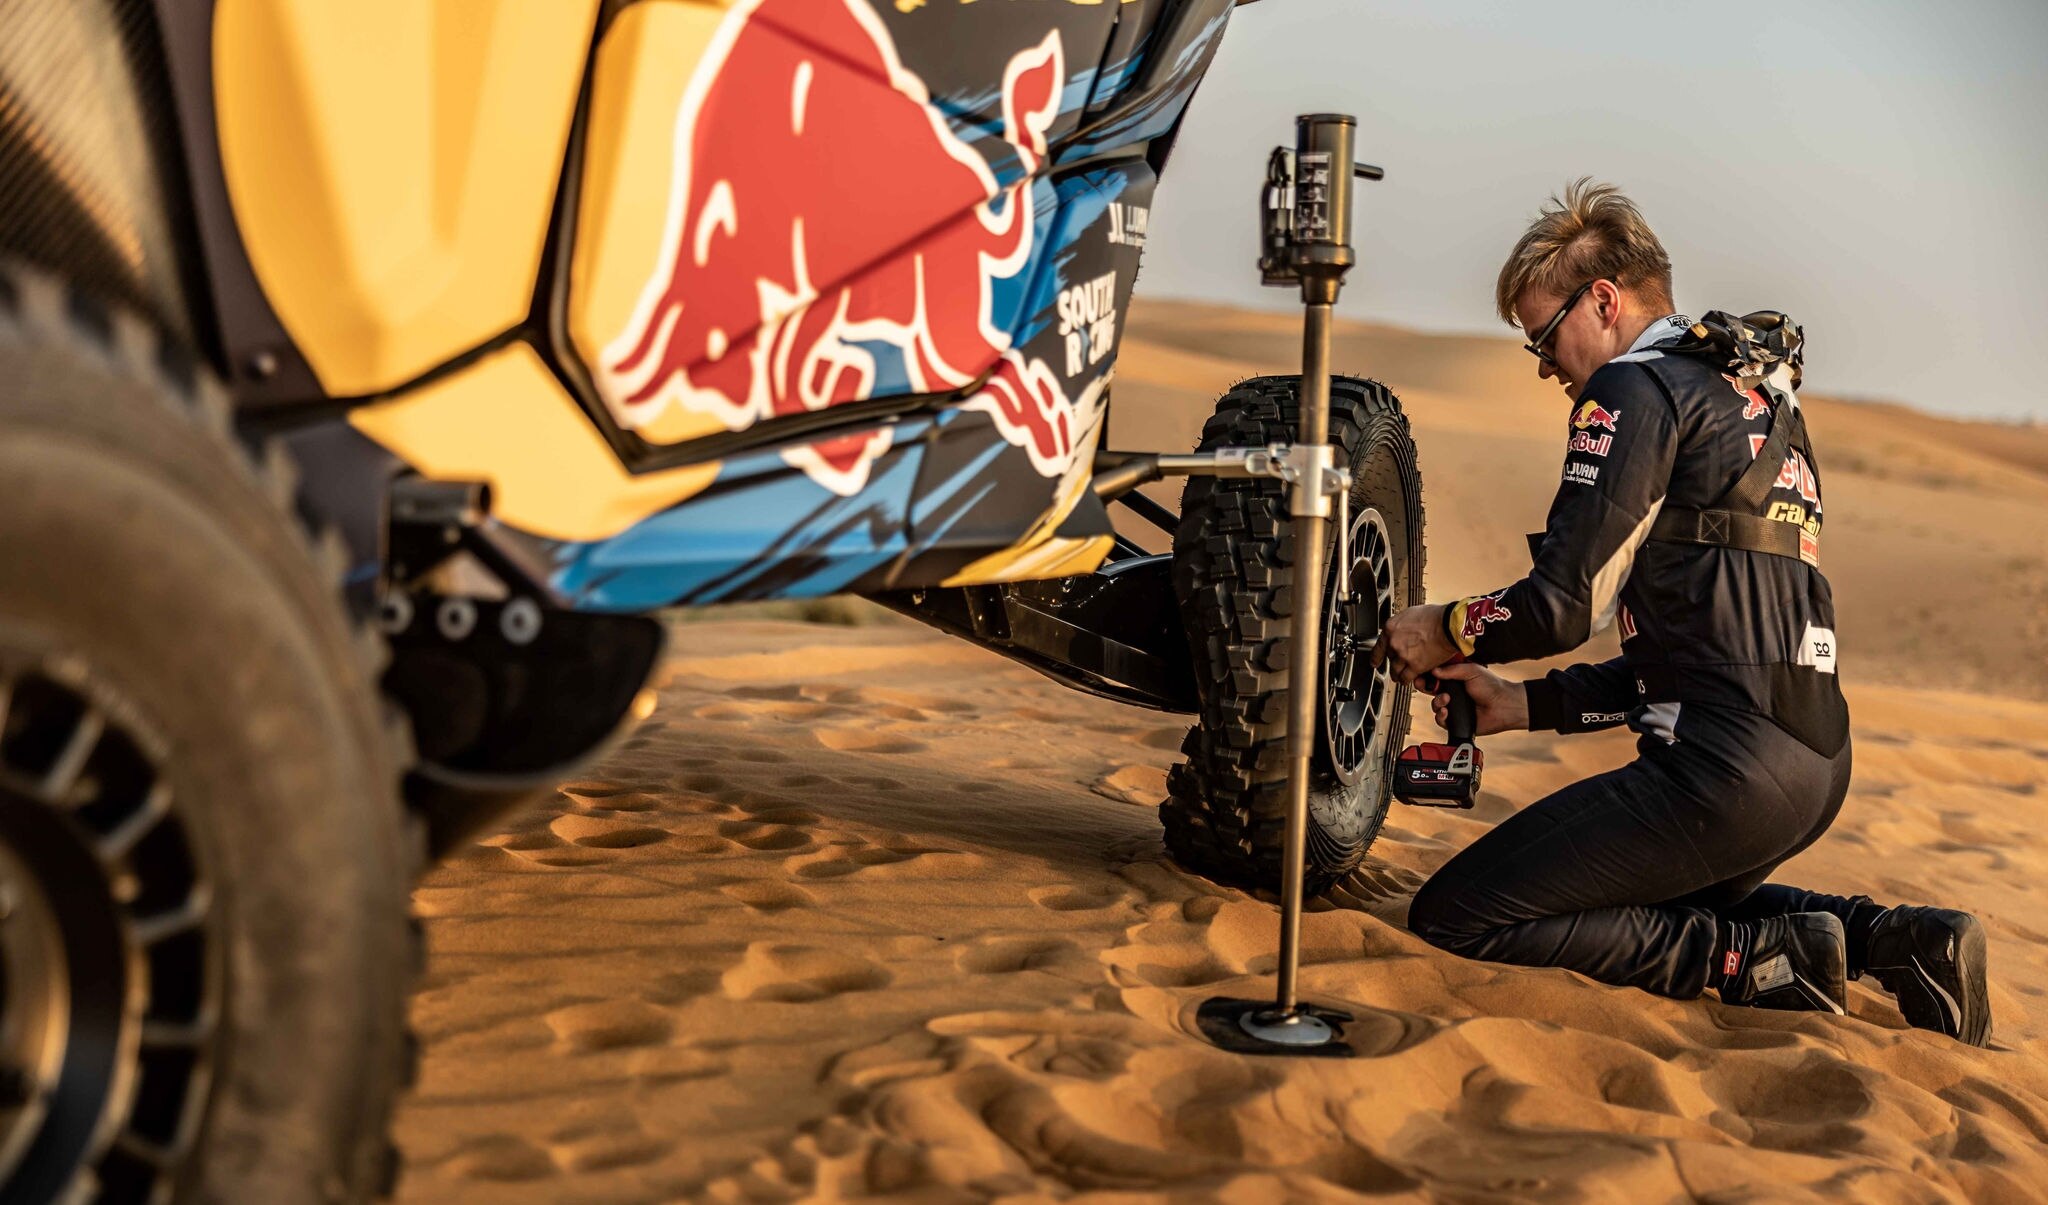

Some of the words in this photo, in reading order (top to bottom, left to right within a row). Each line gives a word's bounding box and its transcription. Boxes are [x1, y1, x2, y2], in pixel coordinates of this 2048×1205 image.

[1058, 271, 1117, 335] SOUTH
[1577, 431, 1613, 457] Bull
[1582, 711, 1626, 724] parco
